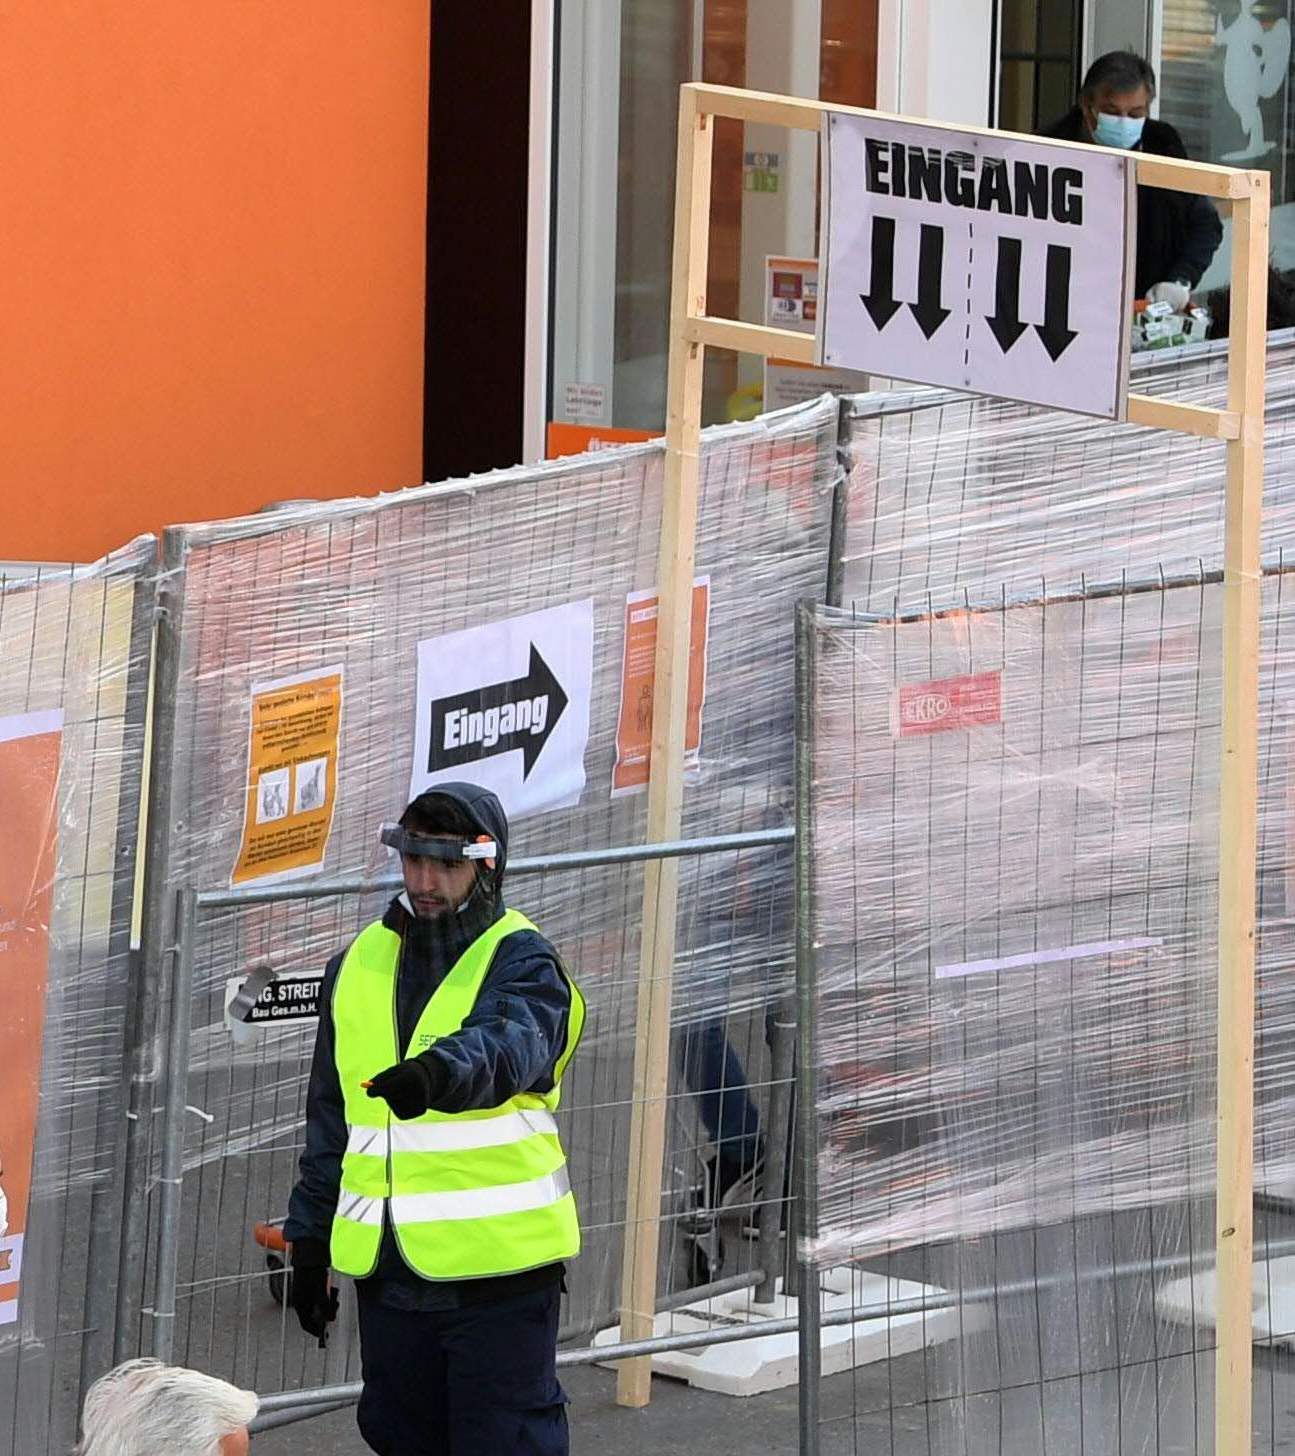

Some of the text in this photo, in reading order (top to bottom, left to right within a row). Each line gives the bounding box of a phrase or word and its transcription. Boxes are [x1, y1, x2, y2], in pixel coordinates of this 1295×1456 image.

[864, 138, 1083, 226] EINGANG
[443, 694, 549, 750] Eingang
[252, 1002, 317, 1018] Bau Ges.m.b.H.
[278, 981, 321, 1001] STREIT
